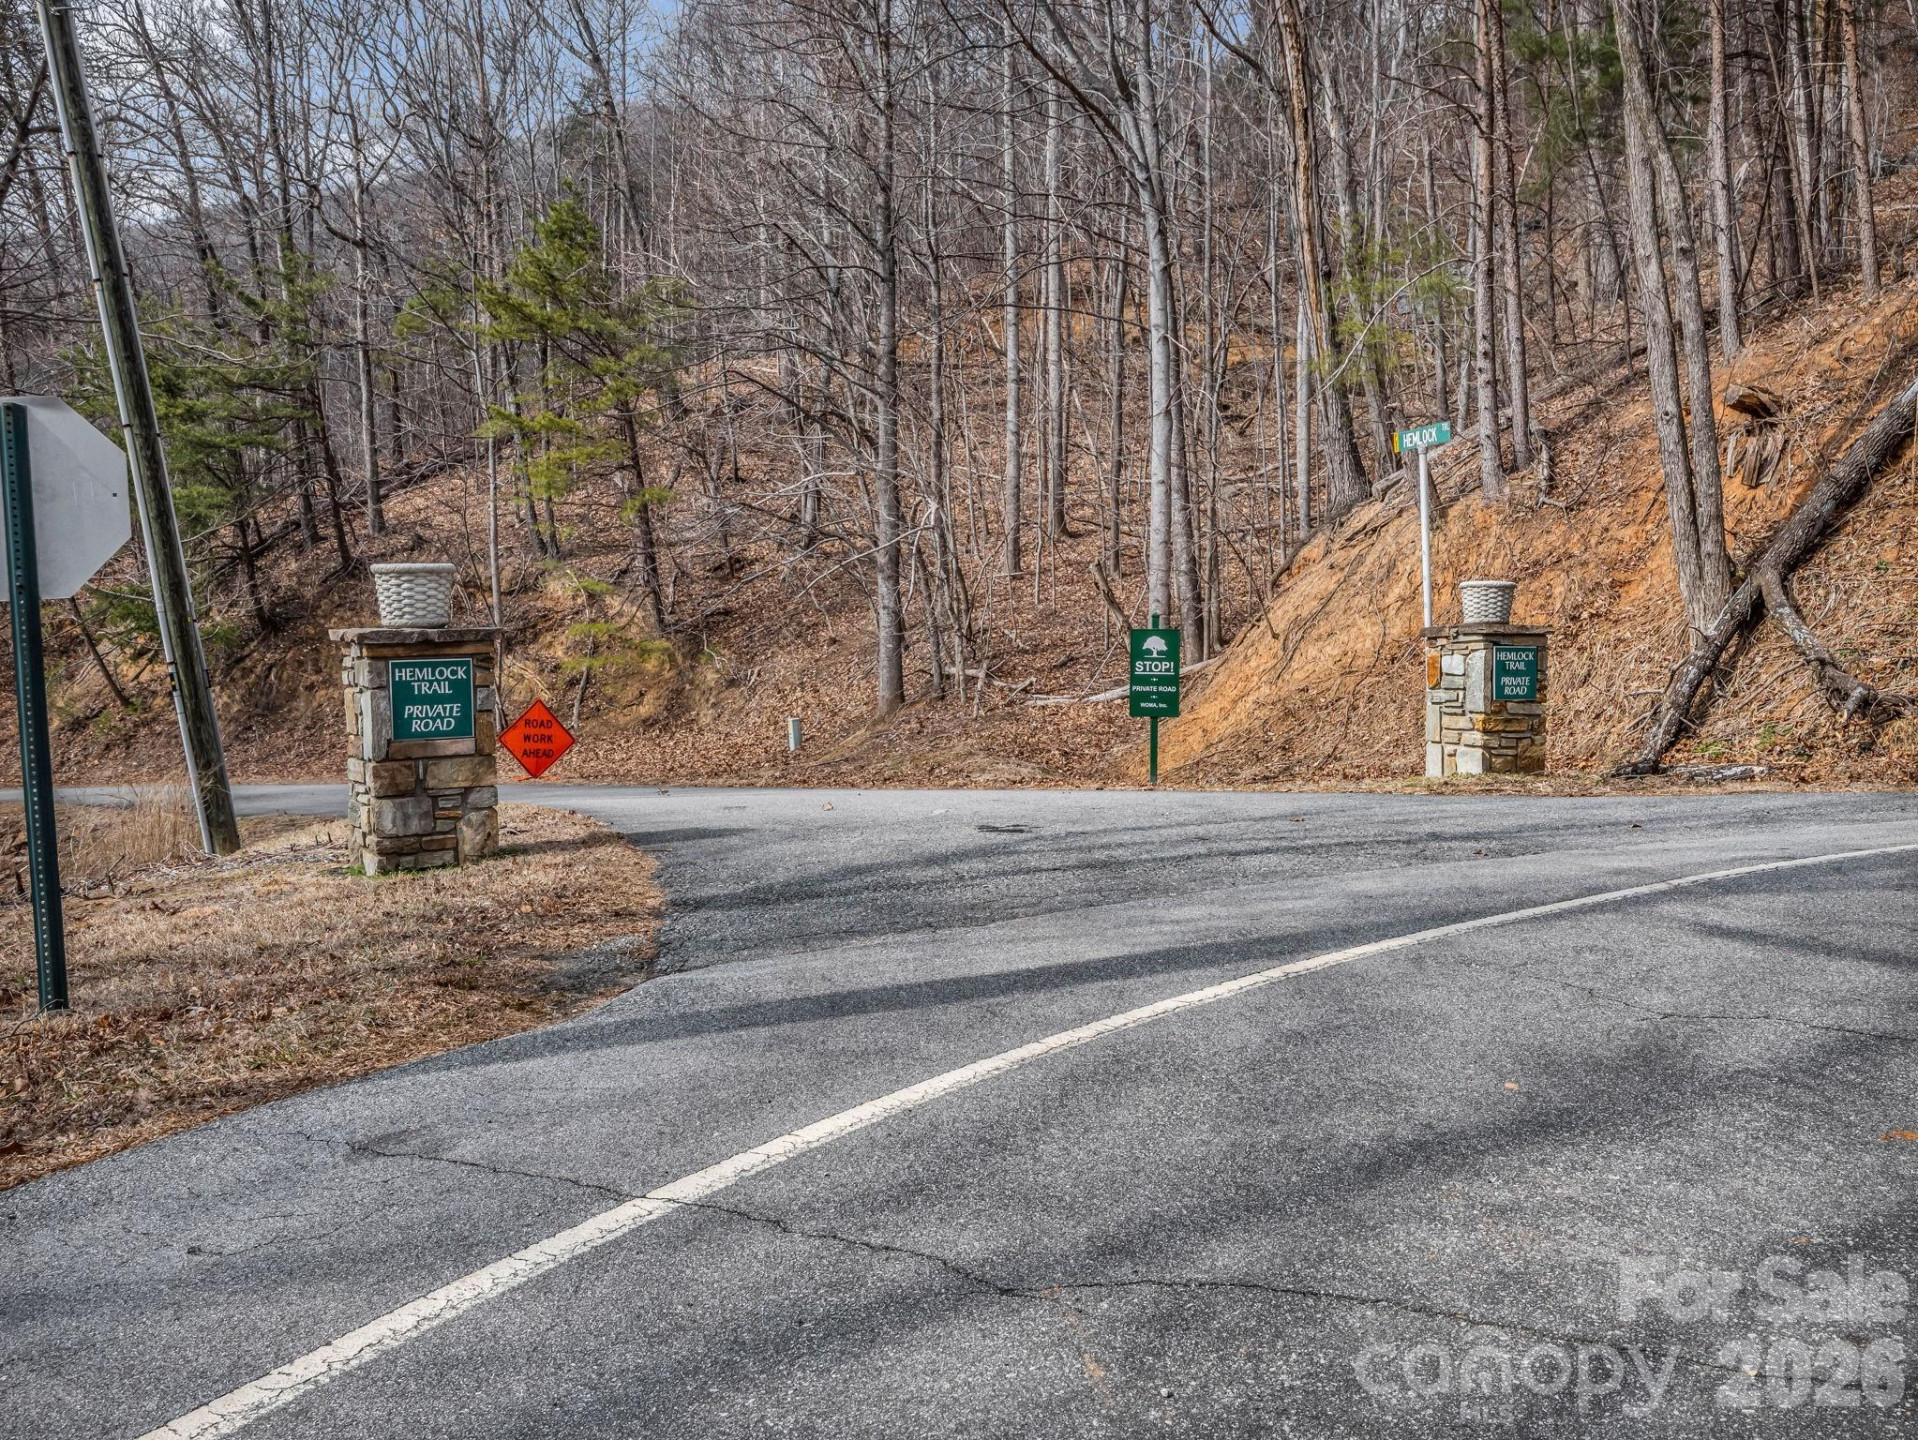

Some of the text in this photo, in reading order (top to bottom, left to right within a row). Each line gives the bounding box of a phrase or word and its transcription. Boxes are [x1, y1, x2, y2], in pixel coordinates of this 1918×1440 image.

[1403, 427, 1437, 448] HEMLOCK
[1497, 651, 1534, 661] HEMLOCK
[1135, 661, 1174, 672] STOP!
[1505, 661, 1526, 670] TRAIL
[395, 666, 467, 681] HEMLOCK
[1501, 676, 1530, 686] PRIVATE
[411, 681, 453, 695] TRAIL
[1504, 685, 1527, 695] ROAD
[404, 704, 461, 718] PRIVATE
[411, 718, 455, 732] ROAD
[525, 719, 553, 729] ROAD
[523, 734, 553, 743] WORK
[522, 749, 554, 758] AHEAD
